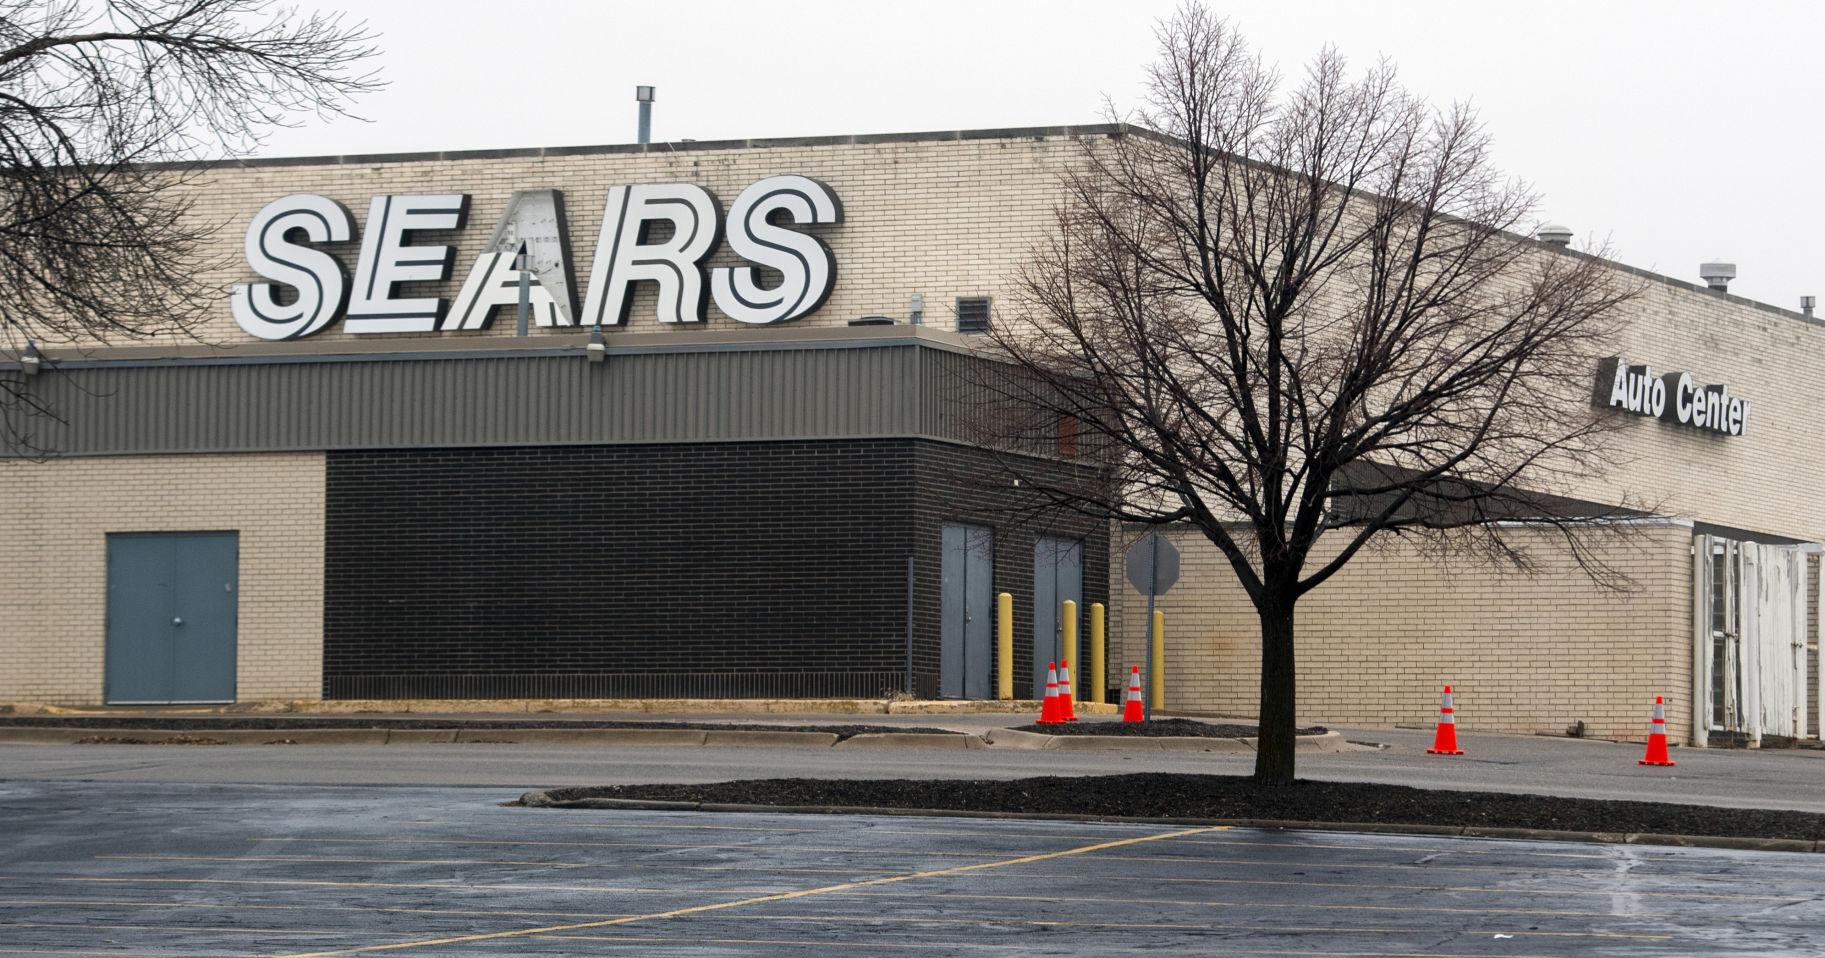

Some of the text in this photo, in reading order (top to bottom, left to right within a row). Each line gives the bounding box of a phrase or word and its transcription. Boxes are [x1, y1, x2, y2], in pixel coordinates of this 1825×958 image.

[231, 175, 837, 339] SEARS
[1610, 357, 1752, 436] Auto Center
